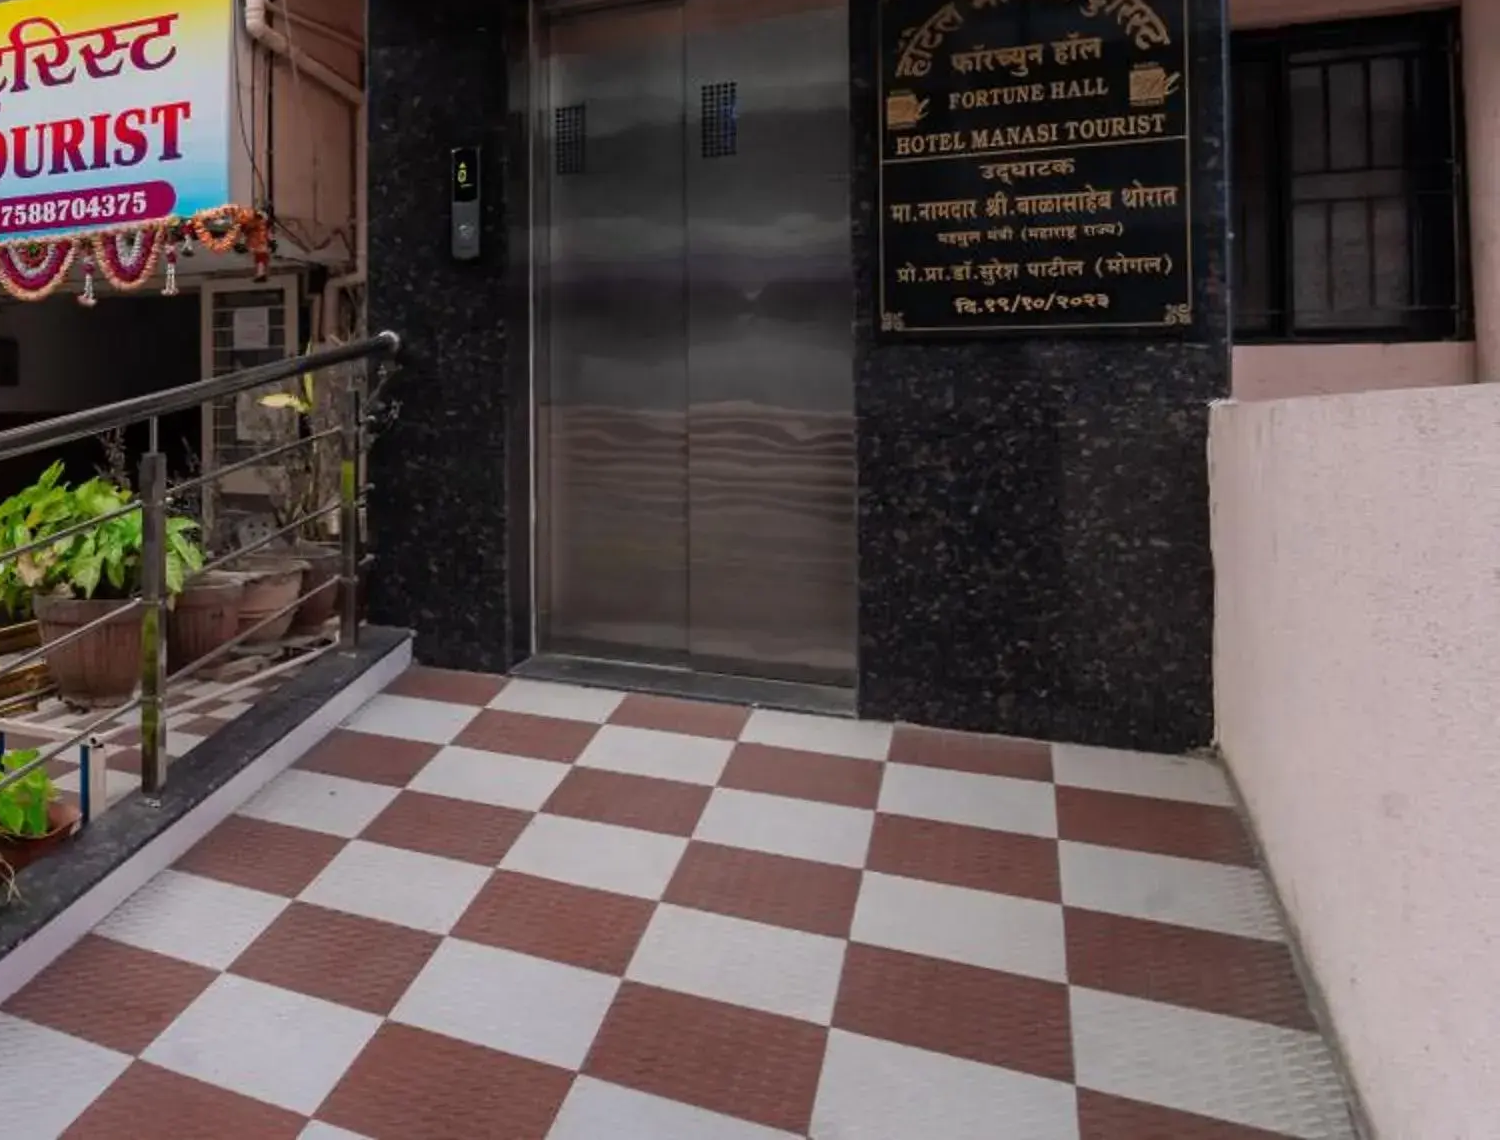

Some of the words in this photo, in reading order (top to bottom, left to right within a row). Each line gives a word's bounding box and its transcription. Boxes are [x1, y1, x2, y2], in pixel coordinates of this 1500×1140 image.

[1054, 32, 1103, 65] हॉल
[949, 85, 1045, 110] FORTUNE
[1051, 77, 1109, 98] HALL
[896, 131, 965, 156] HOTEL
[971, 124, 1059, 149] MANASI
[1065, 114, 1166, 140] TOURIST
[0, 191, 147, 227] 7588704375
[1121, 179, 1178, 208] थोरात
[1027, 255, 1083, 278] पाटील
